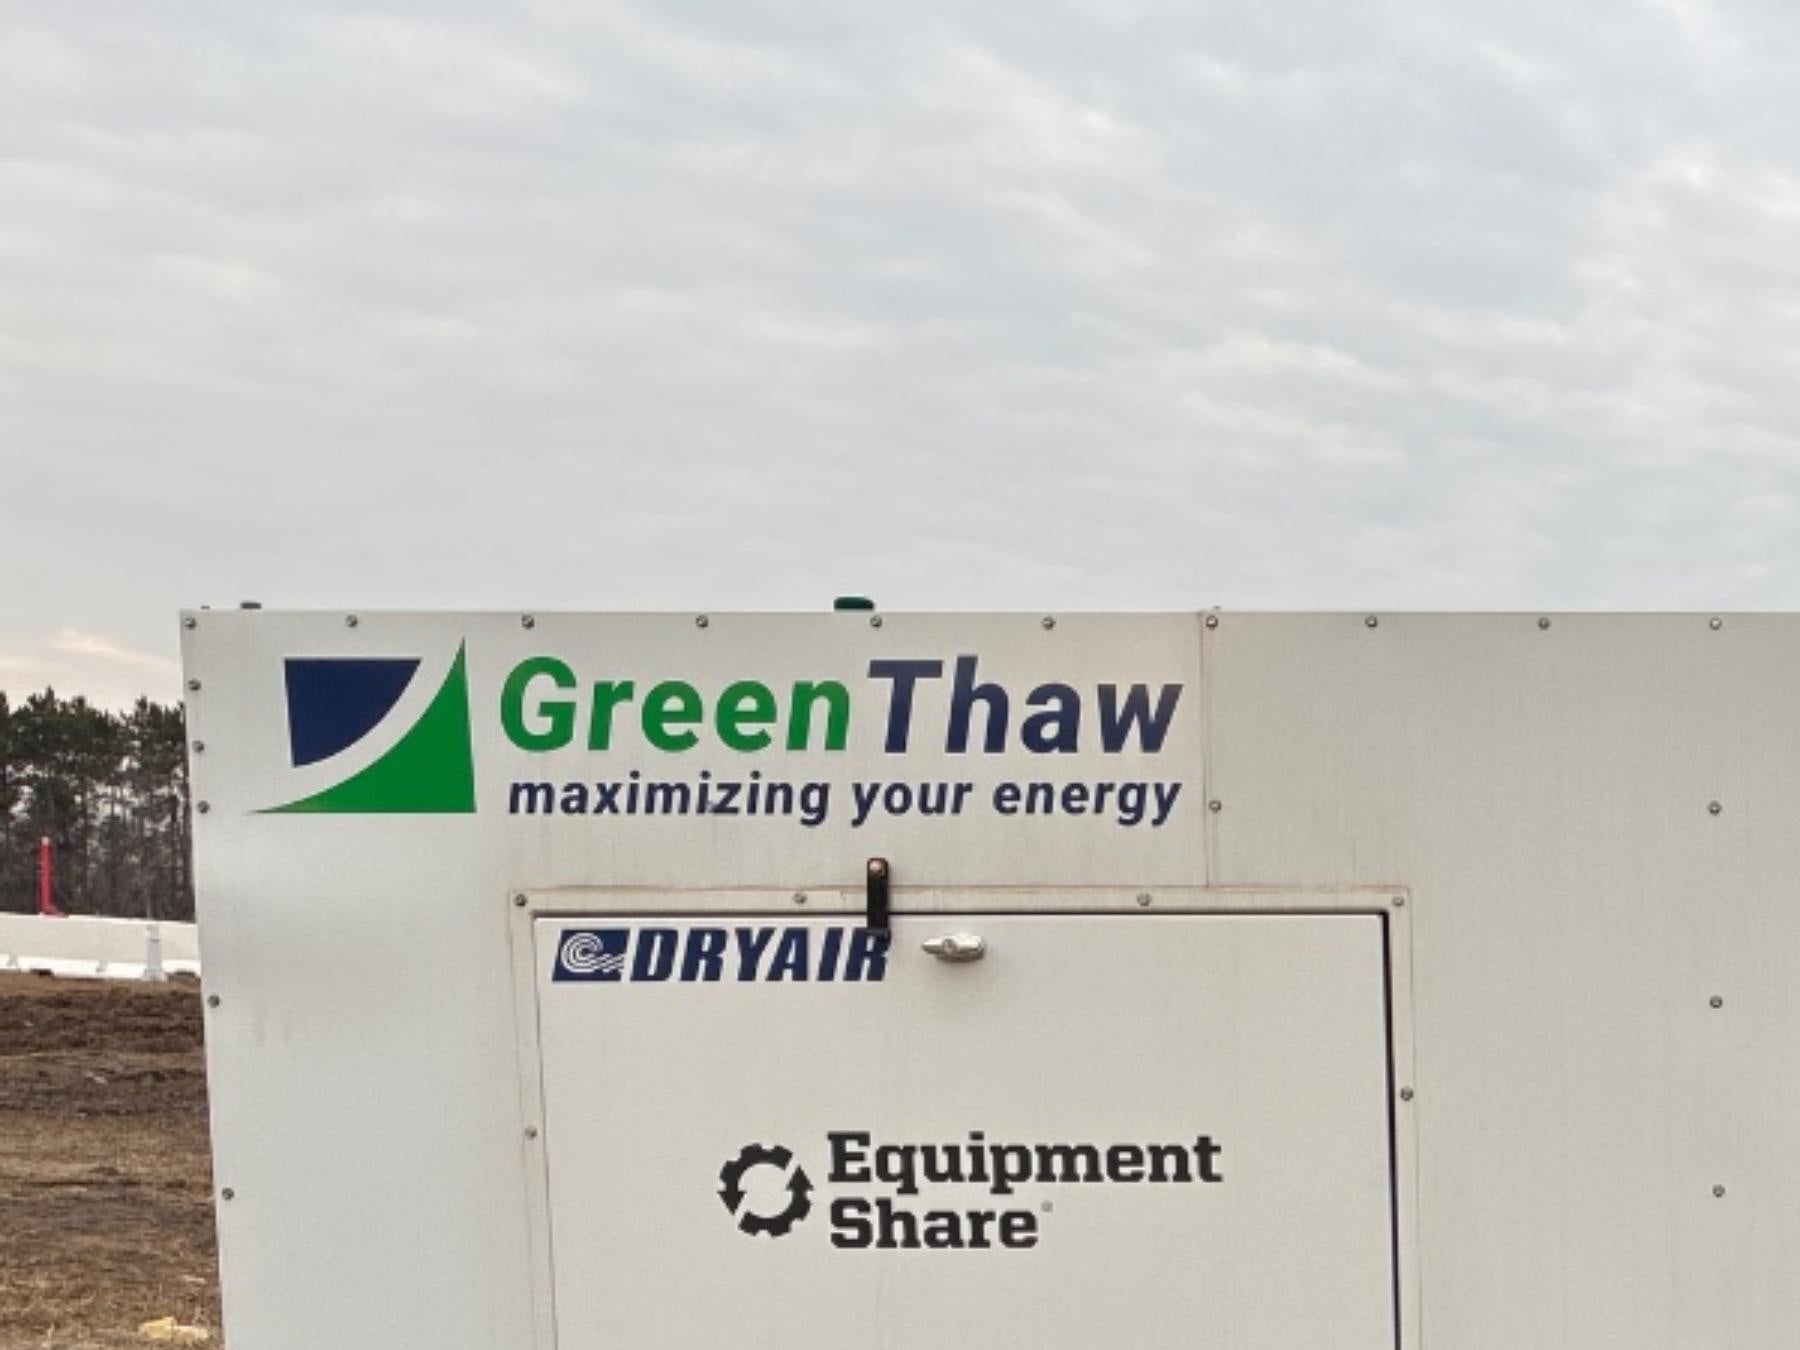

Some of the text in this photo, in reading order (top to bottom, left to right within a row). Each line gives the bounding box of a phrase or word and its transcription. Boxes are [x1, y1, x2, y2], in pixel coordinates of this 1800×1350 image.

[509, 770, 1184, 828] maximizing your energy
[629, 926, 893, 982] DRYAIR
[828, 1131, 1224, 1195] Equipment
[830, 1197, 1039, 1250] Share
